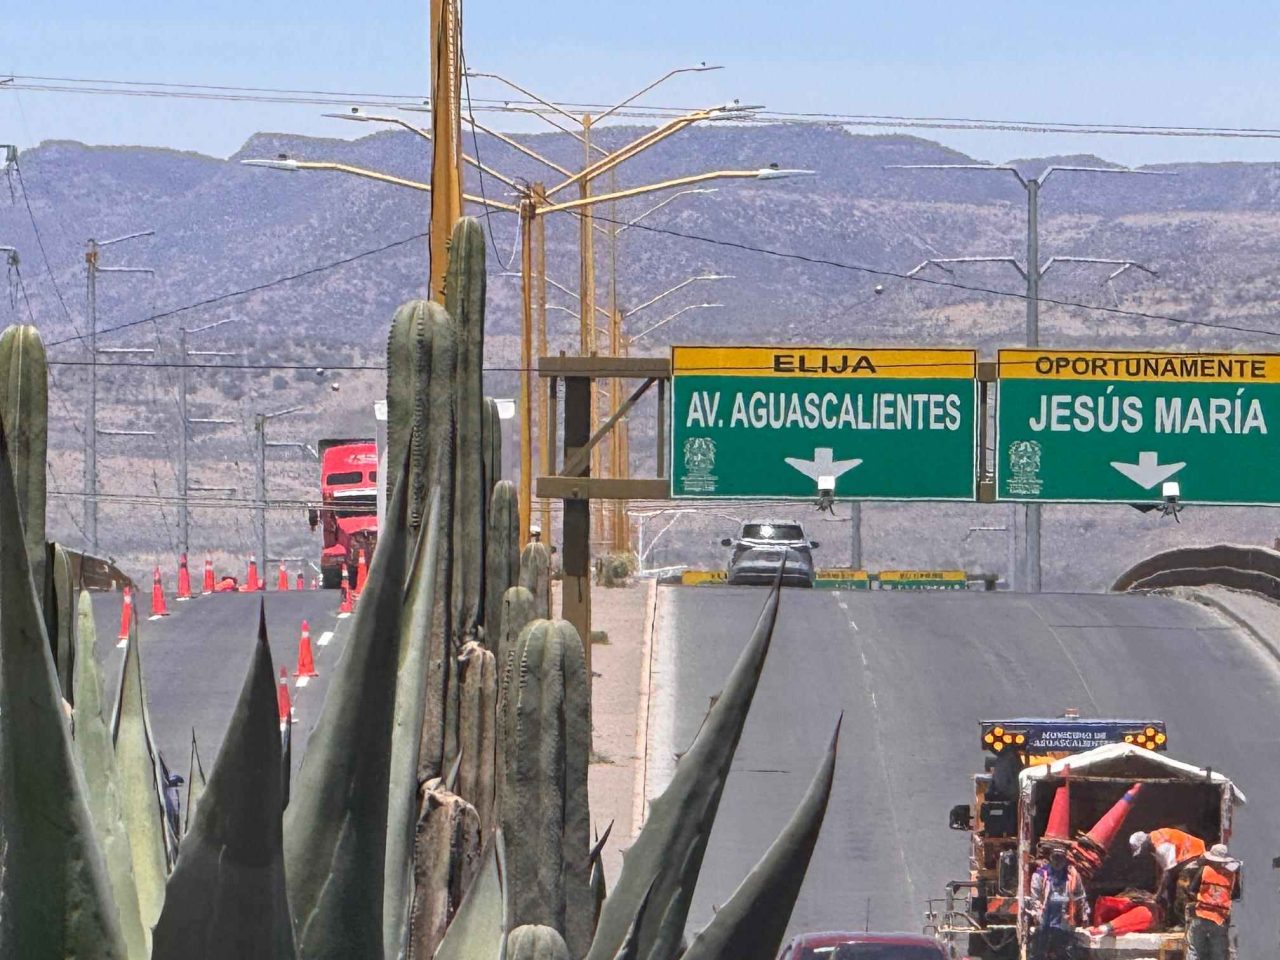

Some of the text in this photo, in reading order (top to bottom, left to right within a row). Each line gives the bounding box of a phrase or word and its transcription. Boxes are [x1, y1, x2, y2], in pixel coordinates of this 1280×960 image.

[773, 354, 877, 374] ELIJA
[1035, 356, 1267, 379] OPORTUNAMENTE
[686, 391, 961, 431] AV. AGUASCALIENTES
[1029, 385, 1268, 434] JESÚS MARÍA
